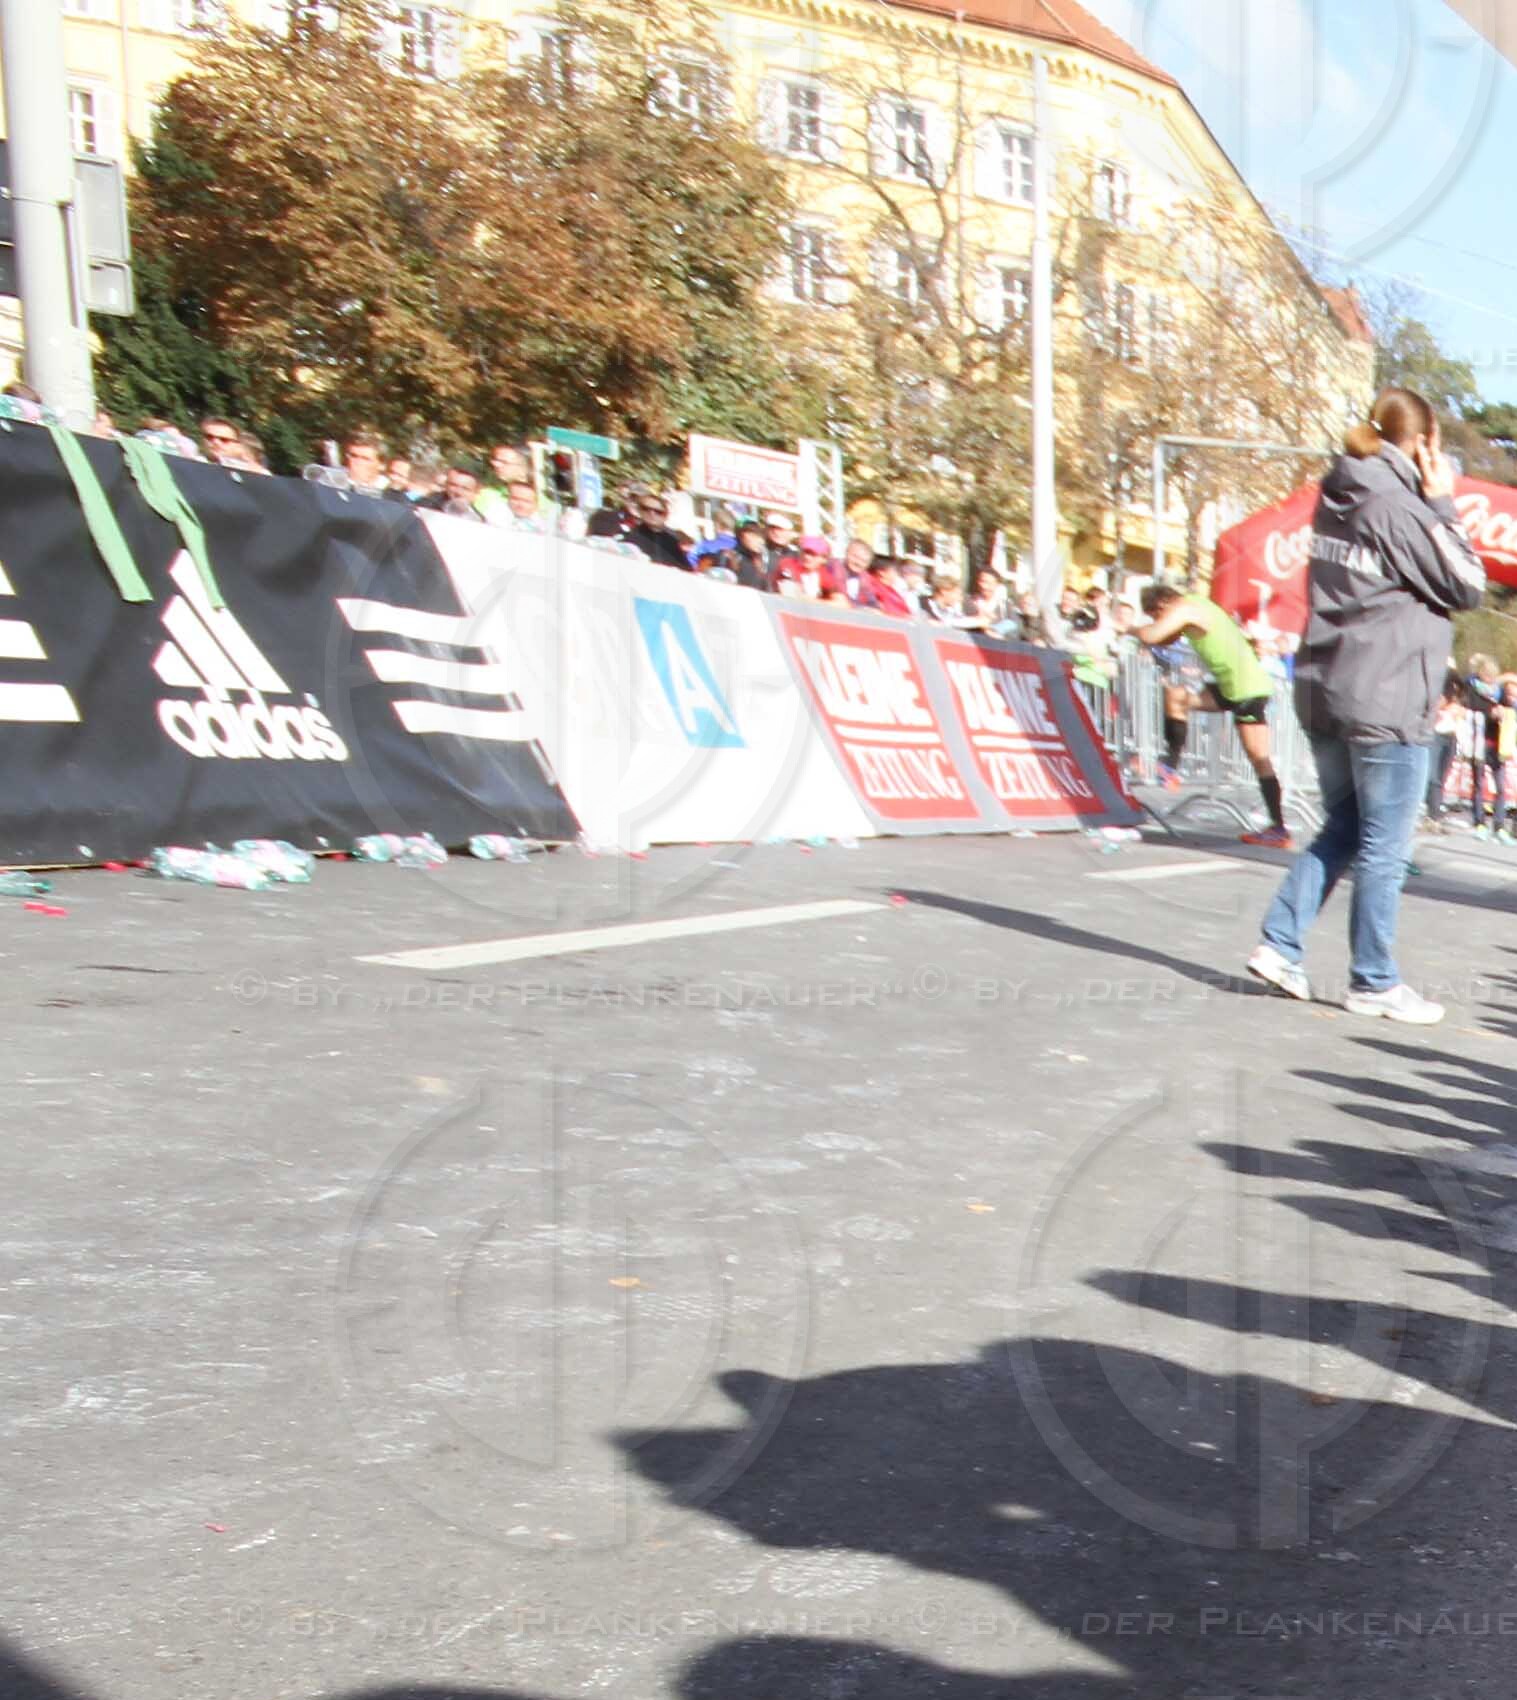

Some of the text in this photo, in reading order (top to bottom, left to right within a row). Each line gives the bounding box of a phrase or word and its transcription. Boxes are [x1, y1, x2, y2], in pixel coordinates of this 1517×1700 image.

[793, 635, 934, 727] KLEINE
[944, 659, 1061, 737] KLEINE
[159, 684, 349, 762] adidas
[843, 742, 965, 800] ZEITUNG
[978, 751, 1094, 799] ZEITUNG
